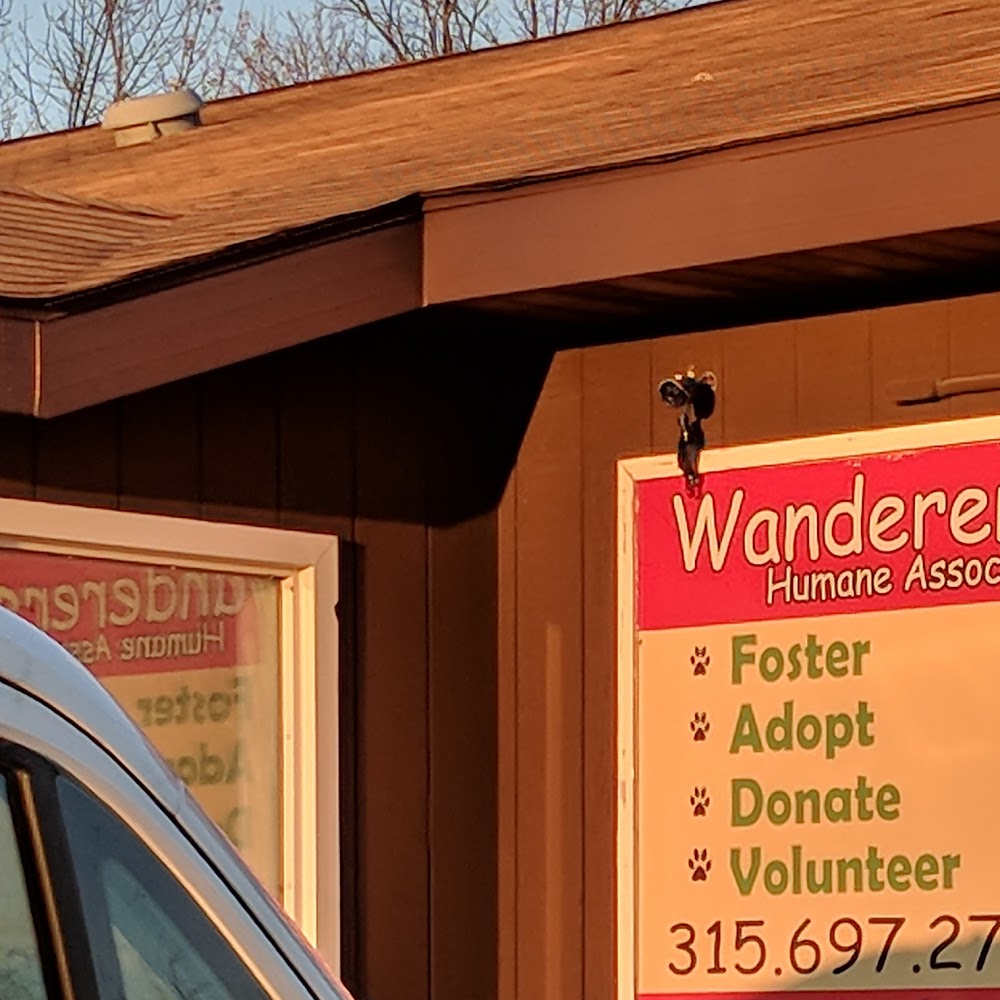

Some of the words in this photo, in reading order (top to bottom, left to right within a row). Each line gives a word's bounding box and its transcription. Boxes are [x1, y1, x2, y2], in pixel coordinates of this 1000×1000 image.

[766, 564, 894, 605] Humane
[730, 633, 871, 685] Foster
[728, 699, 875, 760] Adopt
[730, 775, 901, 828] Donate
[729, 845, 961, 896] Volunteer
